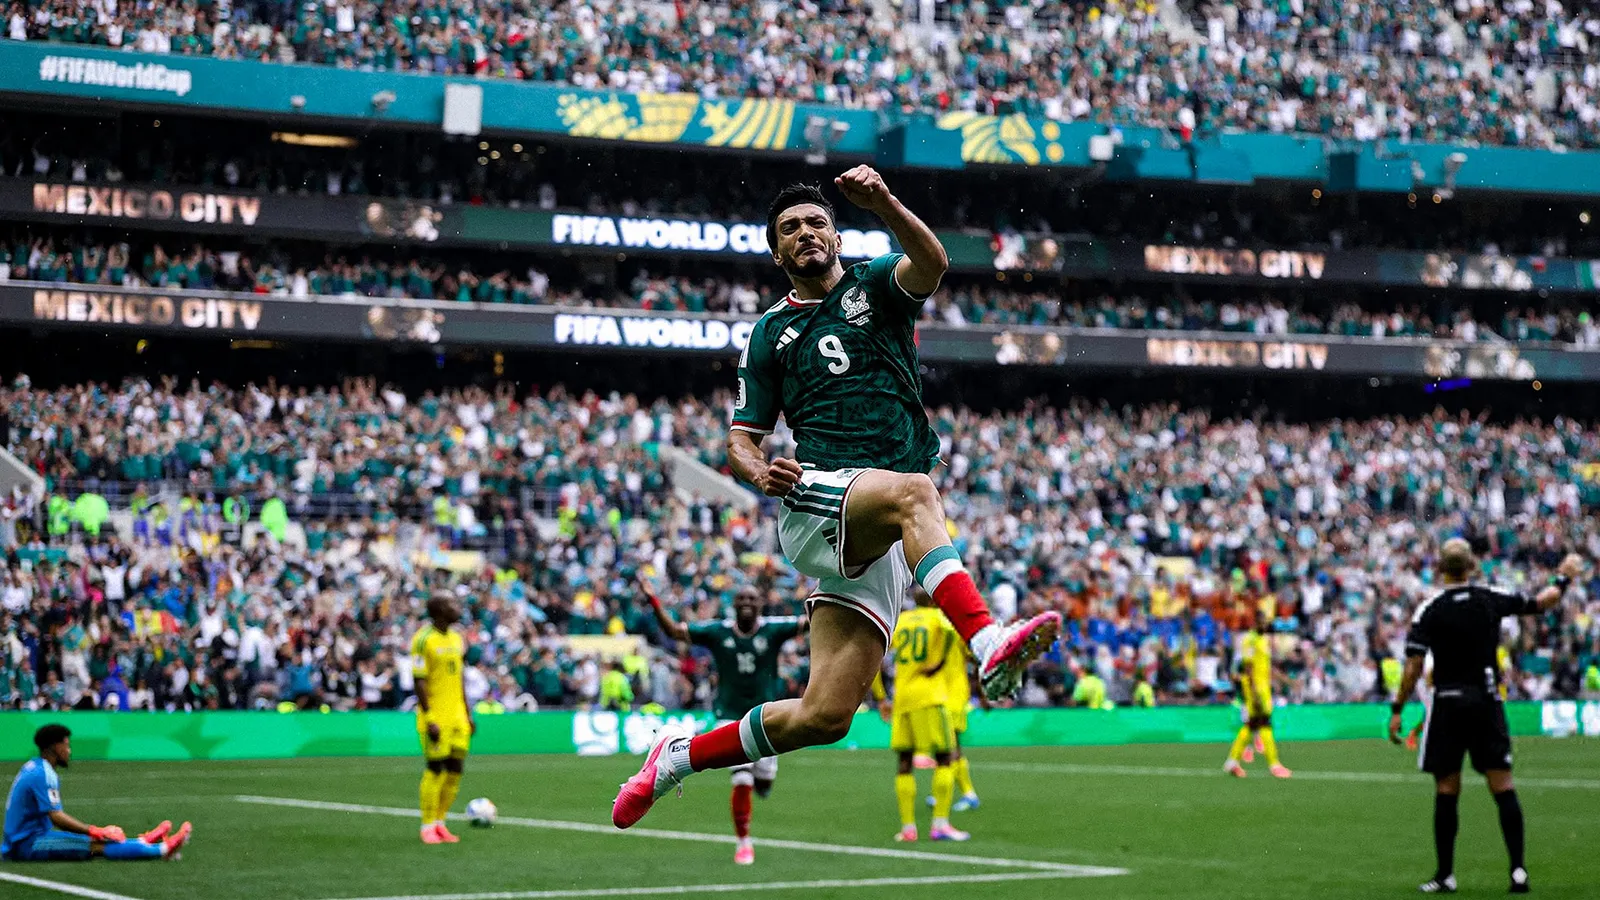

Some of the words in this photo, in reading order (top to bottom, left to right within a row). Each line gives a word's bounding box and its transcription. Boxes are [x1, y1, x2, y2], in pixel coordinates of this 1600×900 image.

[40, 55, 191, 95] #FIFAWorldCup
[33, 184, 174, 219] MEXICO
[180, 192, 260, 225] CITY
[552, 213, 619, 246] FIFA
[620, 217, 728, 252] WORLD
[729, 224, 768, 253] CU
[1145, 245, 1255, 275] MEXICO
[1259, 250, 1326, 279] CITY
[34, 291, 175, 323] MEXICO
[181, 297, 261, 330] CITY
[554, 313, 623, 346] FIFA
[623, 317, 729, 350] WORLD
[817, 334, 850, 375] 9
[1148, 339, 1257, 367] MEXICO
[1262, 343, 1329, 370] CITY
[893, 627, 928, 664] 20
